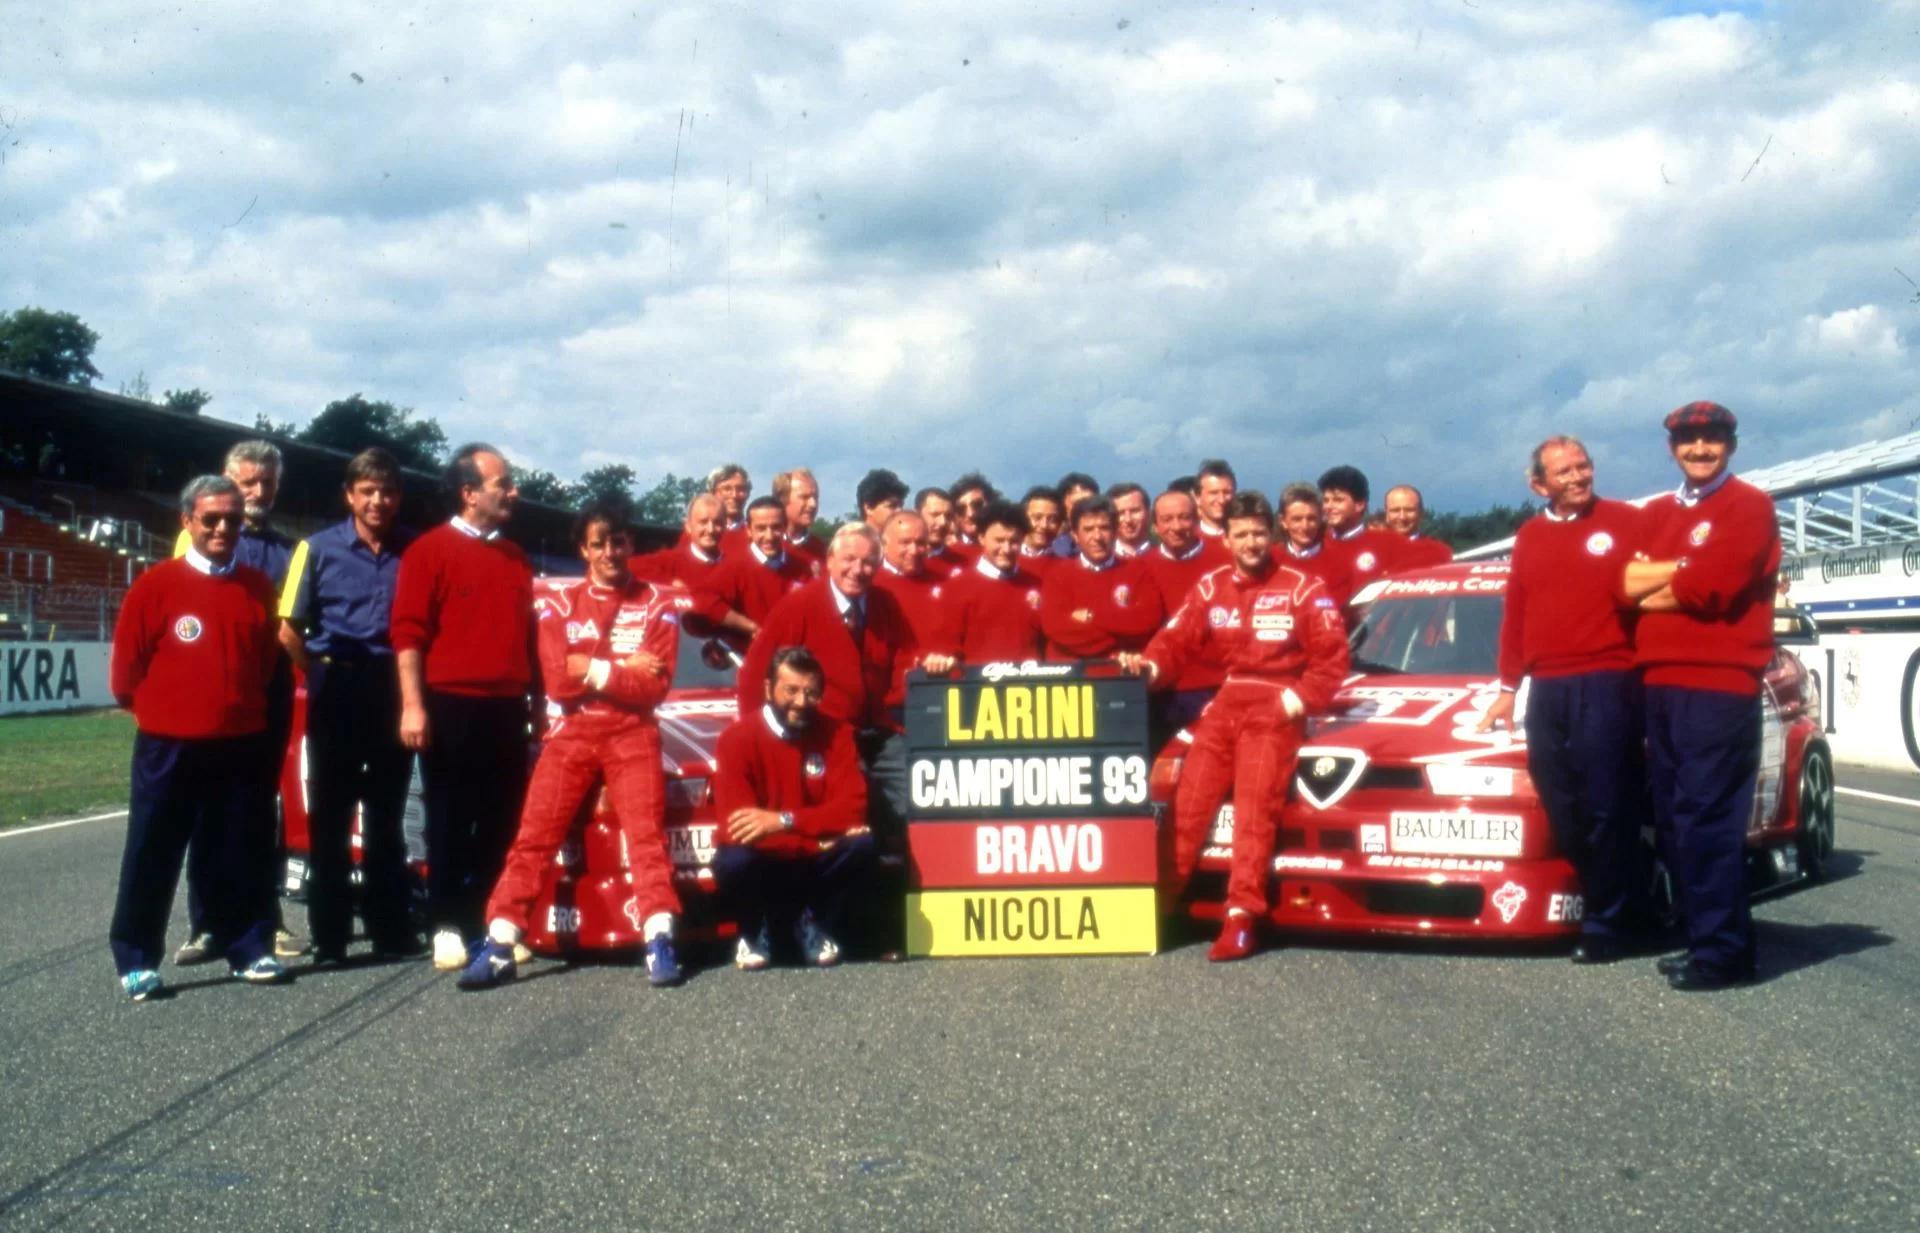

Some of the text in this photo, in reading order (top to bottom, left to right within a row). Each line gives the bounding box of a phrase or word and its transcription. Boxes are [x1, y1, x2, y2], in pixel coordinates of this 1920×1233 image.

[1386, 577, 1508, 594] Philips Car
[1821, 547, 1881, 584] Continental
[0, 648, 80, 701] KRA
[947, 685, 1095, 740] LARINI
[911, 755, 1147, 808] CAMPIONE 93
[976, 823, 1103, 874] BRAVO
[1367, 855, 1505, 873] MICHELIN
[963, 896, 1100, 941] NICOLA
